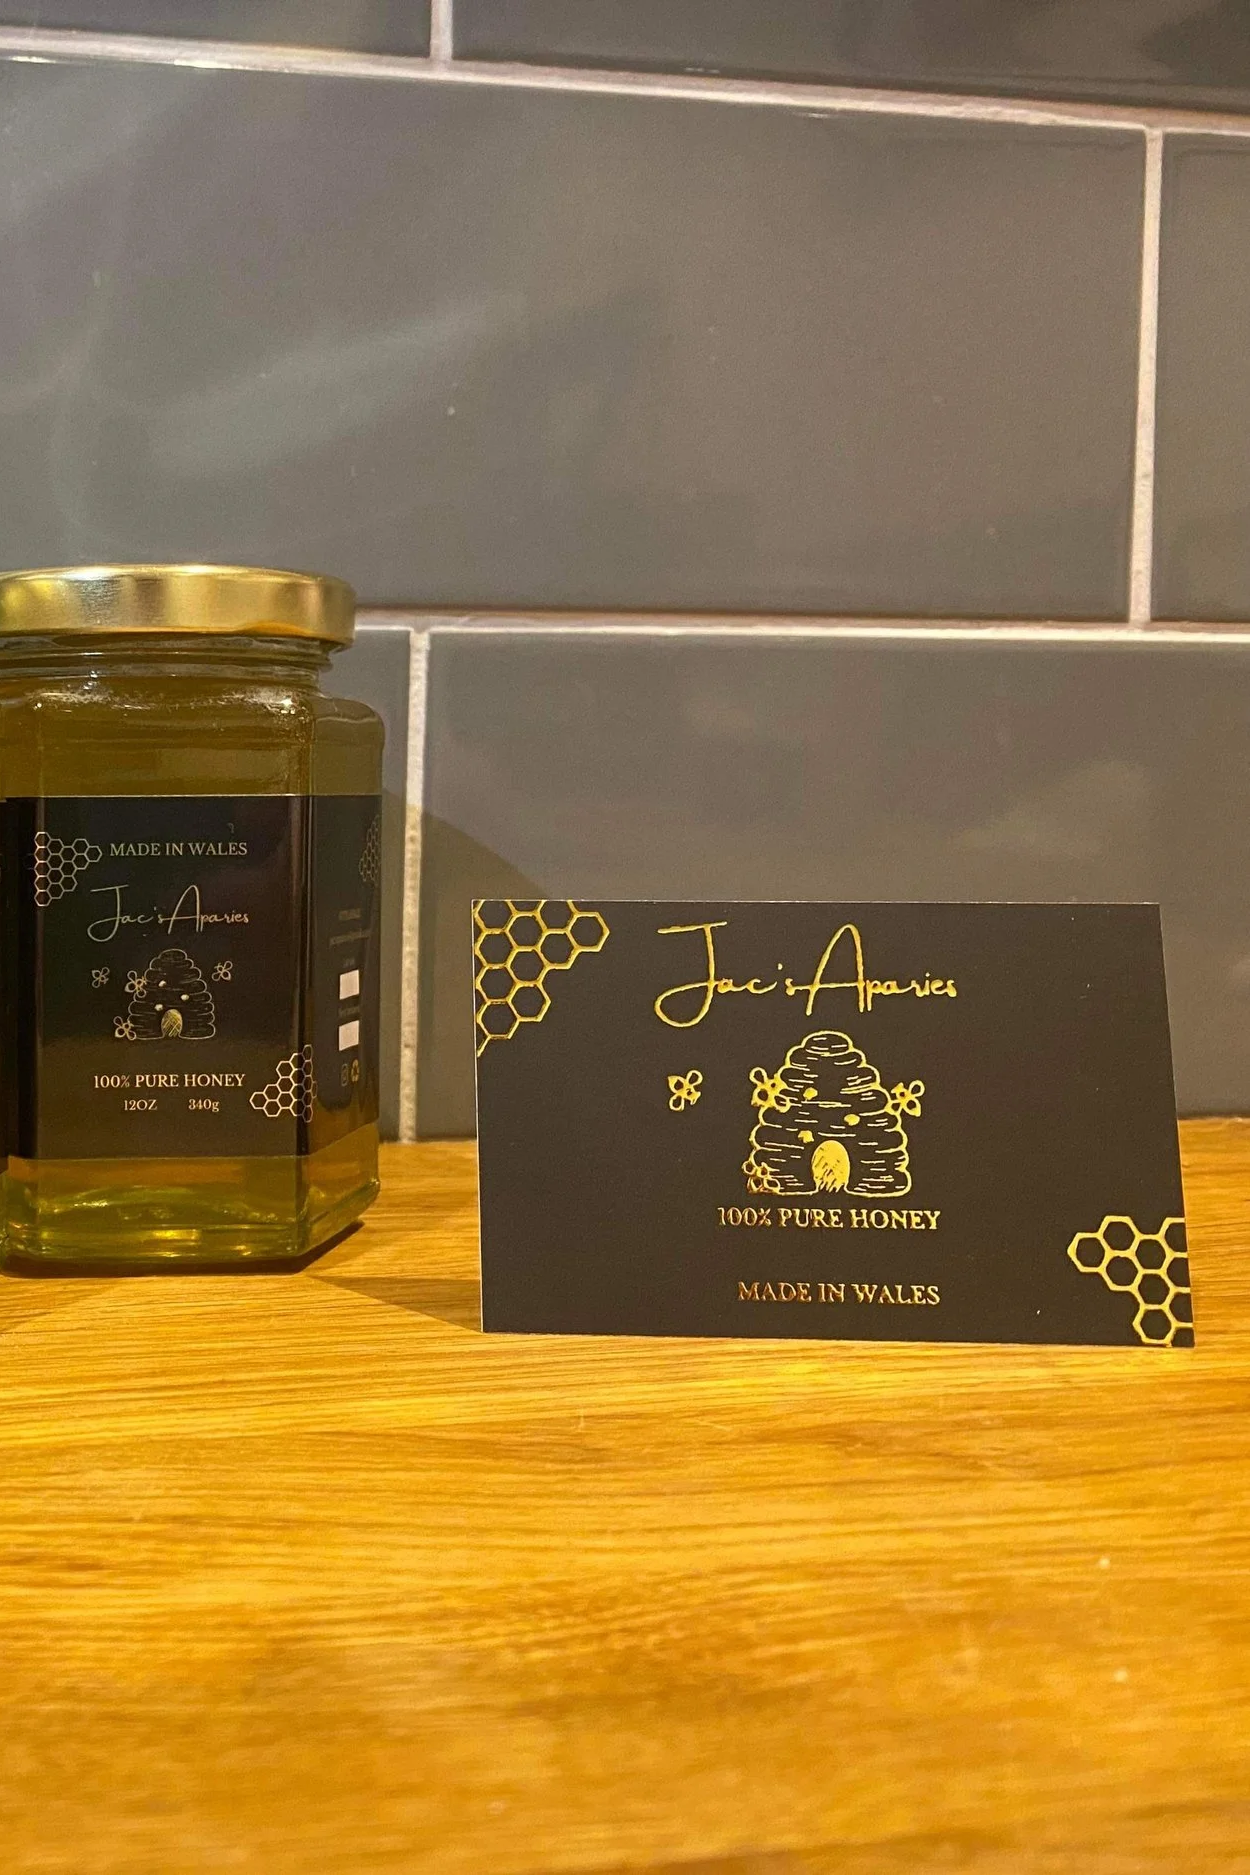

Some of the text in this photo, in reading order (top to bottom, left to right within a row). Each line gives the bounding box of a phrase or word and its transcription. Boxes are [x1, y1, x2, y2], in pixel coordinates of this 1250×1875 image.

[110, 842, 248, 857] MADE IN WALES
[87, 884, 249, 942] Jac's Aparies
[654, 921, 957, 1027] Jac's Aparies
[94, 1073, 246, 1089] 100% PURE HONEY
[124, 1098, 220, 1113] 12OZ 340g
[717, 1206, 941, 1230] 100% PURE HONEY
[738, 1281, 941, 1306] MADE IN WALES
